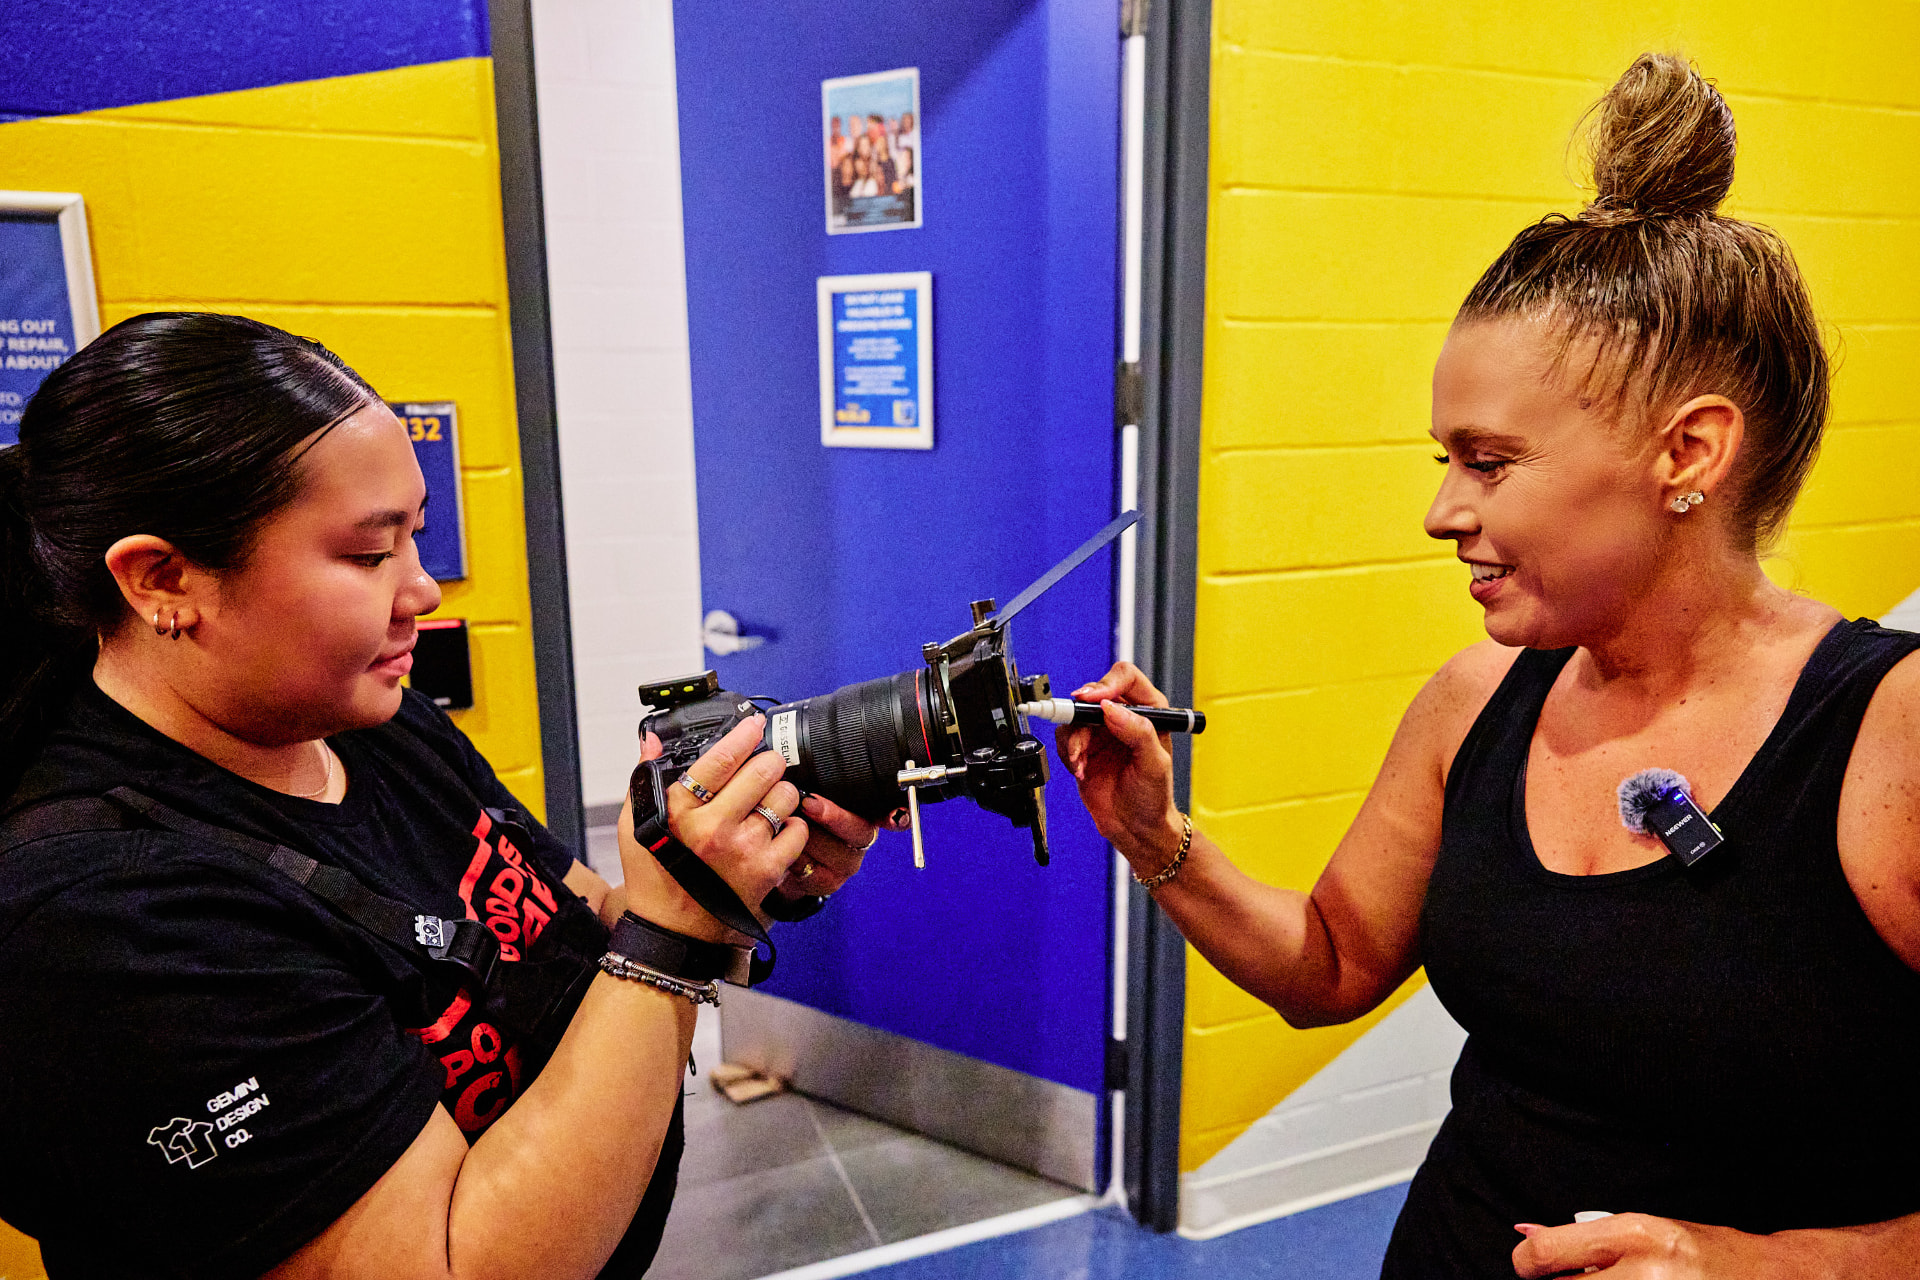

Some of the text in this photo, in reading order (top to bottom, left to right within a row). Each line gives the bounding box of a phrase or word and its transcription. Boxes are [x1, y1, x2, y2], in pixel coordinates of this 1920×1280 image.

[21, 320, 55, 334] OUT
[1665, 814, 1693, 836] NEEWER
[207, 1076, 259, 1112] GEMINI
[216, 1093, 270, 1131] DESIGN
[225, 1129, 253, 1148] CO.
